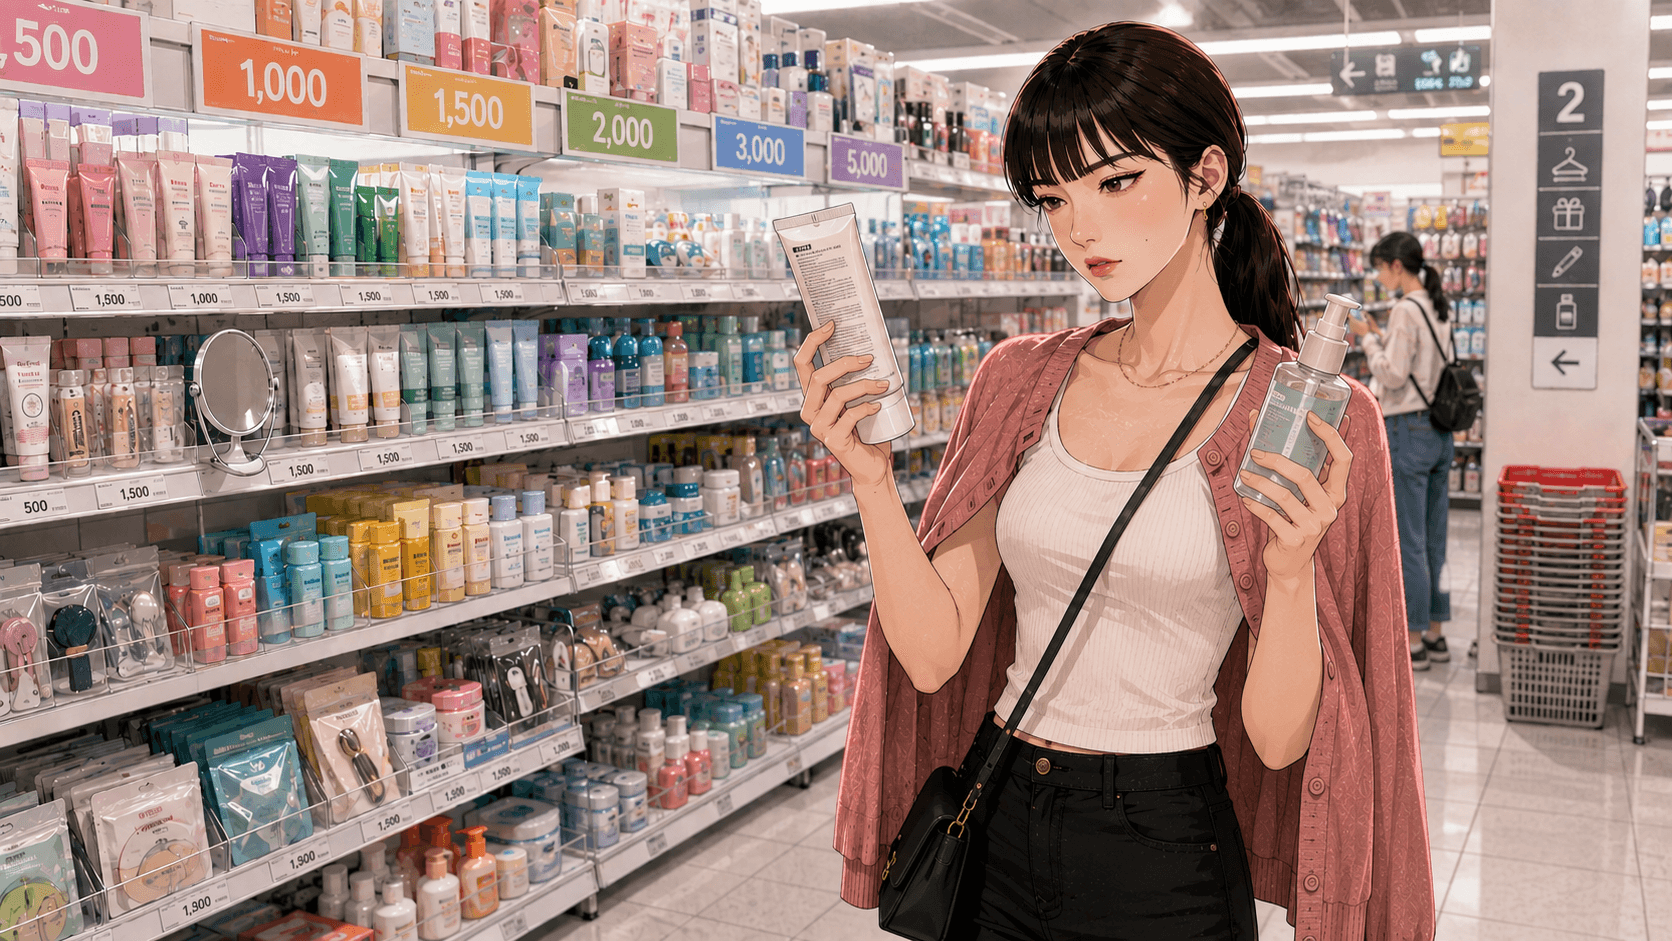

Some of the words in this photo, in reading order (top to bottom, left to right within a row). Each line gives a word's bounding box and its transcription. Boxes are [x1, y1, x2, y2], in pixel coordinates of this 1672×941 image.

[240, 58, 327, 108] 1,000
[434, 88, 504, 130] 1,500
[1556, 81, 1586, 124] 2
[592, 111, 654, 149] 2,000
[736, 133, 786, 166] 3,000
[847, 149, 888, 179] 5,000
[94, 293, 125, 307] 1,500
[190, 293, 218, 306] 1,000
[275, 292, 301, 304] 1,500
[358, 291, 381, 302] 1,500
[428, 290, 449, 302] 1,500
[494, 290, 514, 301] 1,500
[519, 432, 539, 444] 1,500
[451, 441, 473, 454] 1,500
[376, 451, 400, 466] 1,500
[288, 463, 314, 478] 1,500
[119, 486, 150, 501] 1,500
[24, 499, 48, 514] 500
[377, 813, 400, 831] 1,500
